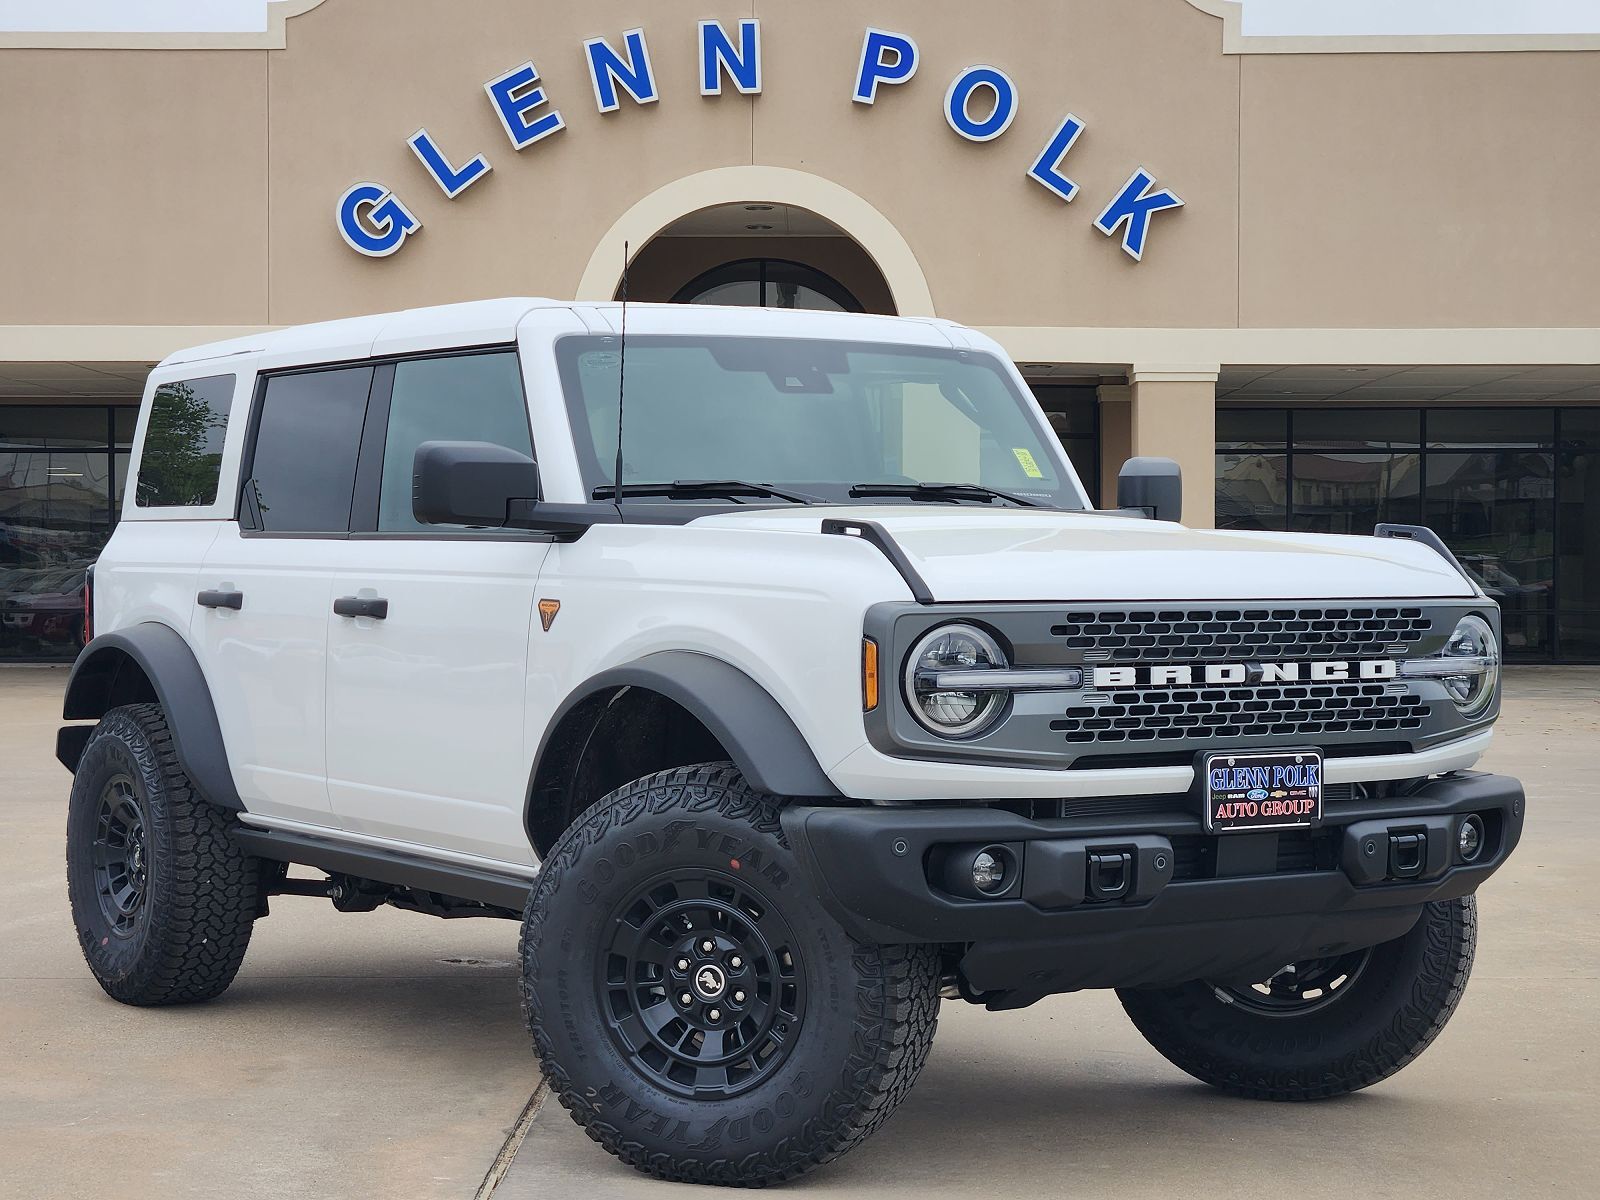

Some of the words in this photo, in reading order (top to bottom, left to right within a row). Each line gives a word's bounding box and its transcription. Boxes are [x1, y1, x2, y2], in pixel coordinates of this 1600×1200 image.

[336, 18, 762, 258] GLENN
[852, 26, 1185, 262] POLK
[1093, 659, 1397, 687] BRONCO
[1210, 766, 1270, 791] GLENN
[1273, 764, 1320, 788] POLK
[1212, 793, 1227, 801] Jeep
[1215, 802, 1258, 819] AUTO
[1260, 799, 1315, 817] GROUP
